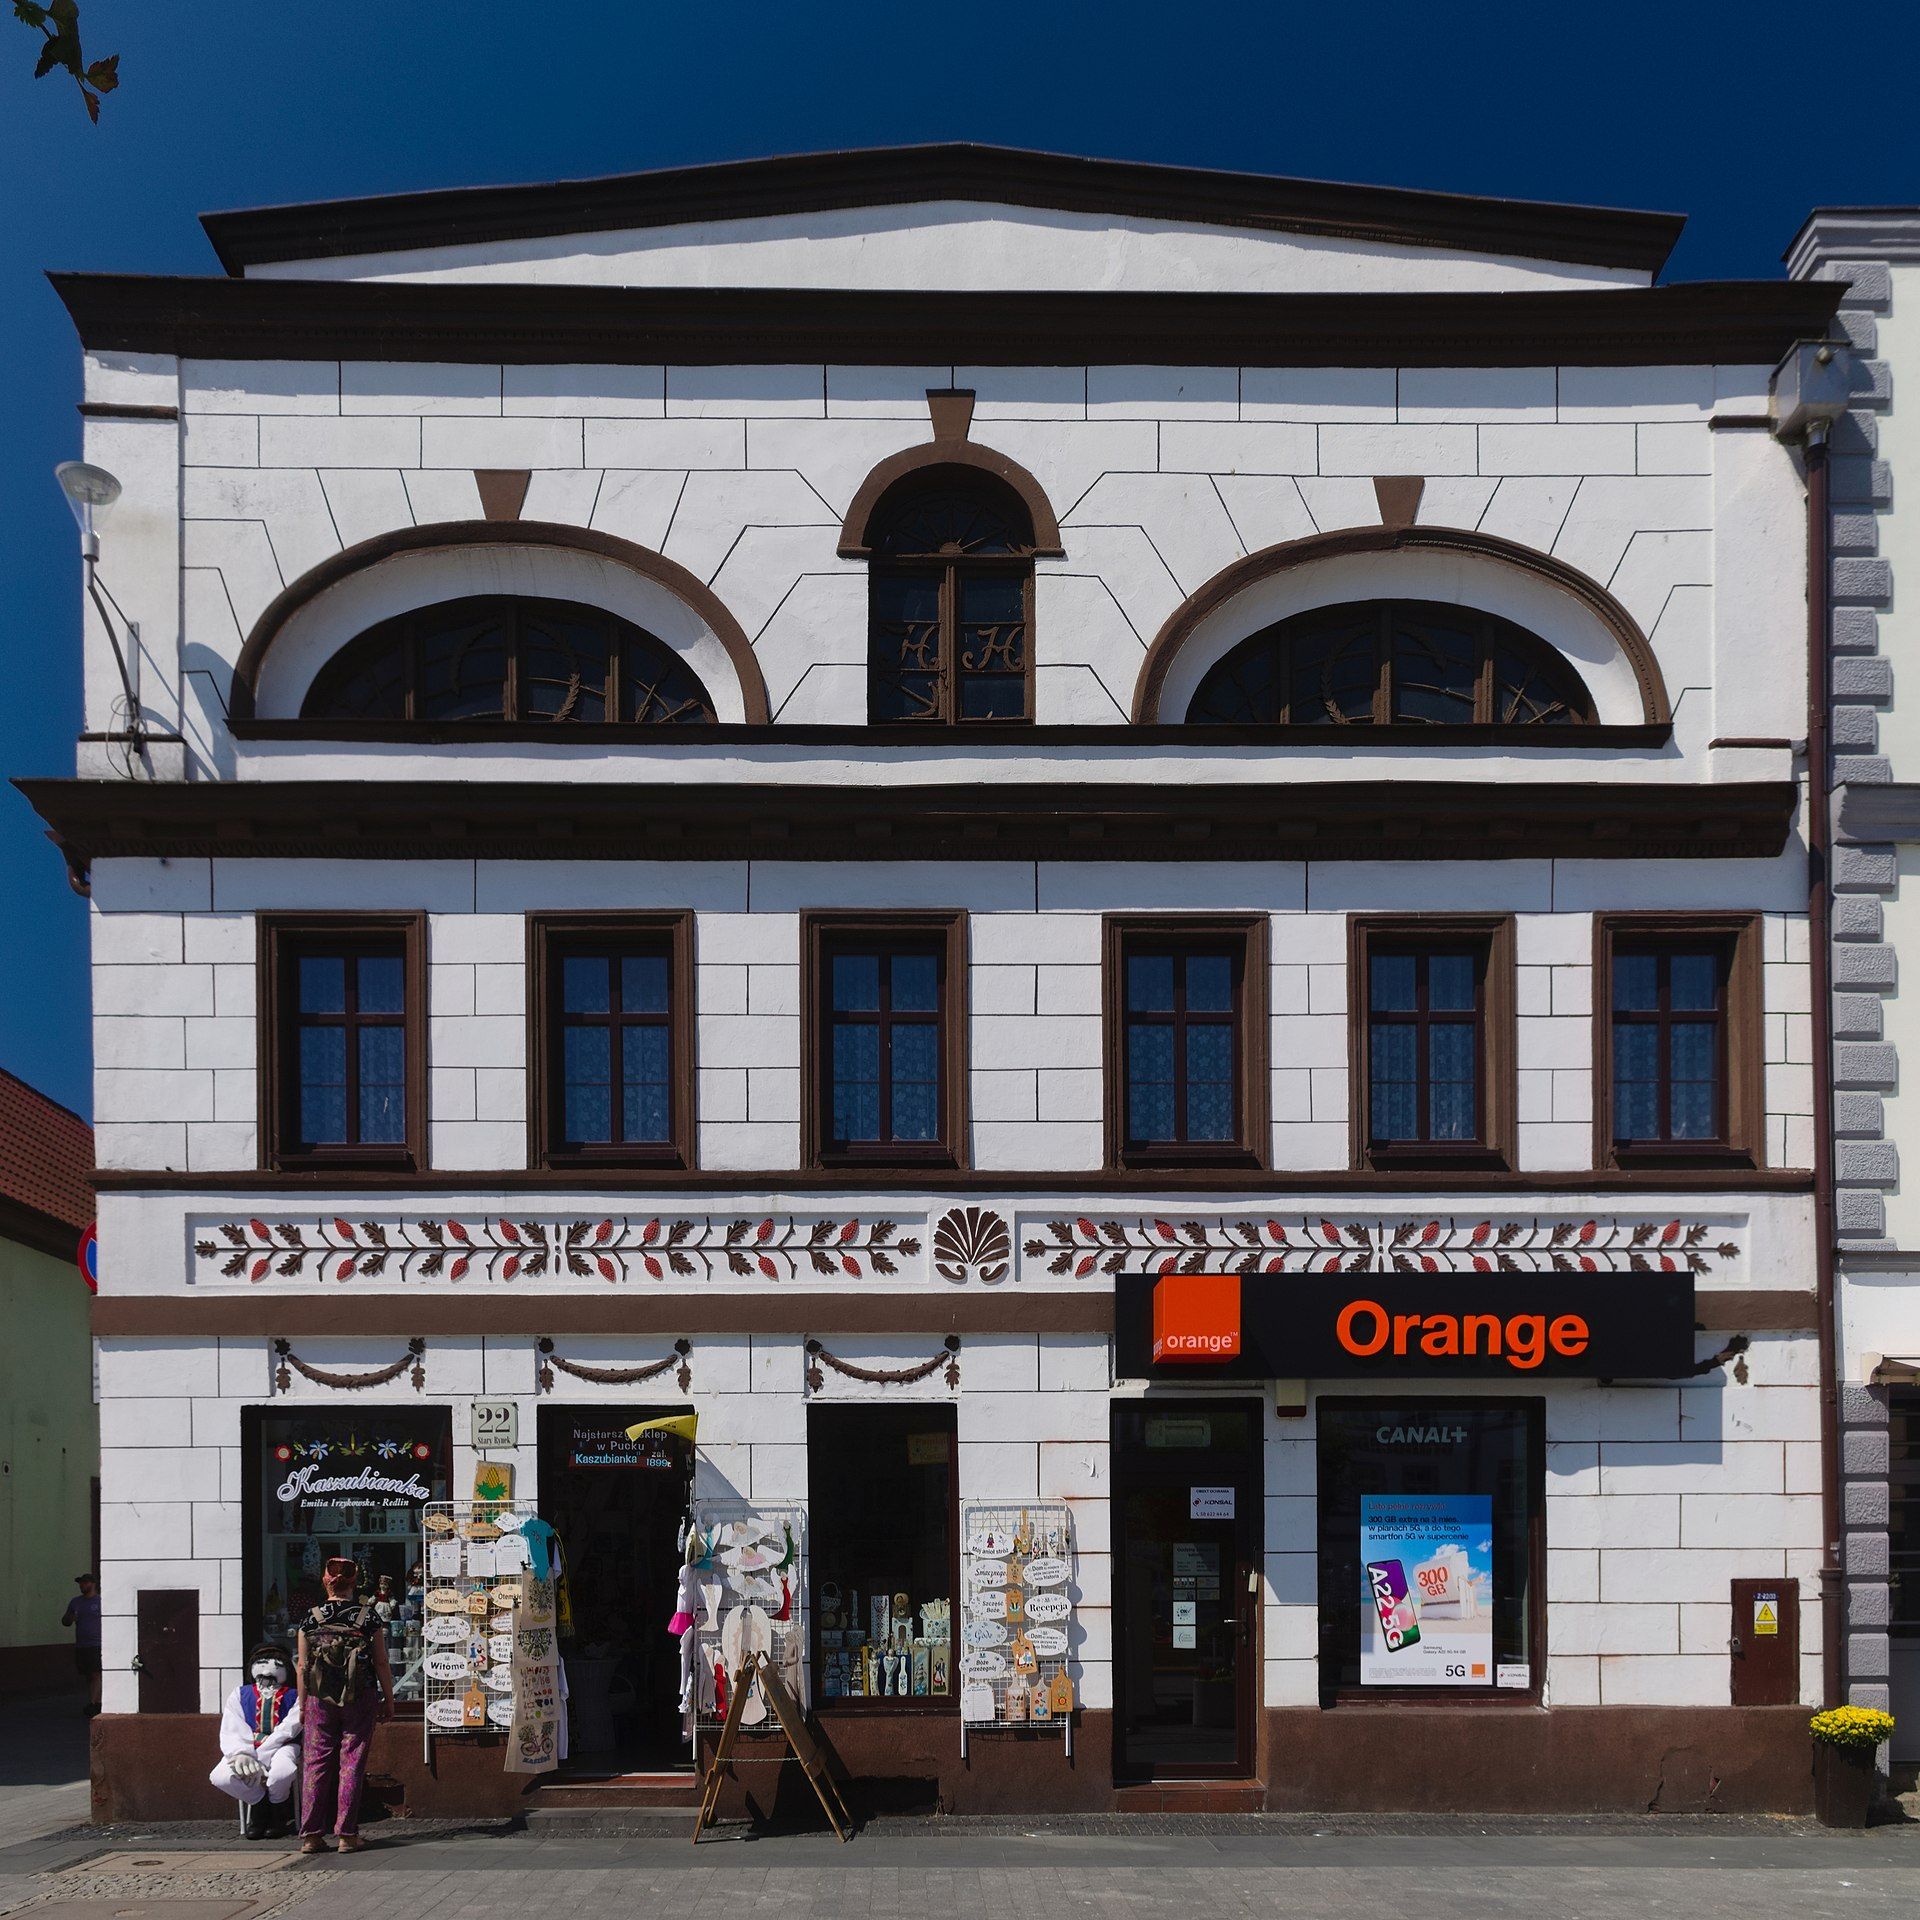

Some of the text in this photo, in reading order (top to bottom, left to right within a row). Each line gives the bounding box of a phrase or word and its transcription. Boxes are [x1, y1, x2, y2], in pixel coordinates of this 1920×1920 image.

[1336, 1299, 1590, 1369] Orange
[477, 1406, 511, 1433] 22
[477, 1435, 512, 1445] Stary Rynek
[1376, 1426, 1468, 1444] CANAL+
[610, 1441, 645, 1451] Pucku
[277, 1464, 430, 1501] Kaszubianka
[300, 1499, 328, 1508] Emilia
[331, 1498, 376, 1510] Irzykowska
[382, 1498, 410, 1507] Redlin
[1377, 1525, 1408, 1533] planach
[1444, 1525, 1461, 1533] tego
[1426, 1533, 1469, 1541] supercenie
[974, 1567, 1007, 1578] Smacznego
[1418, 1566, 1449, 1587] 300
[1368, 1567, 1395, 1611] A22
[1427, 1583, 1447, 1597] GB
[1030, 1602, 1068, 1613] Recepcja
[1446, 1665, 1466, 1677] 5G
